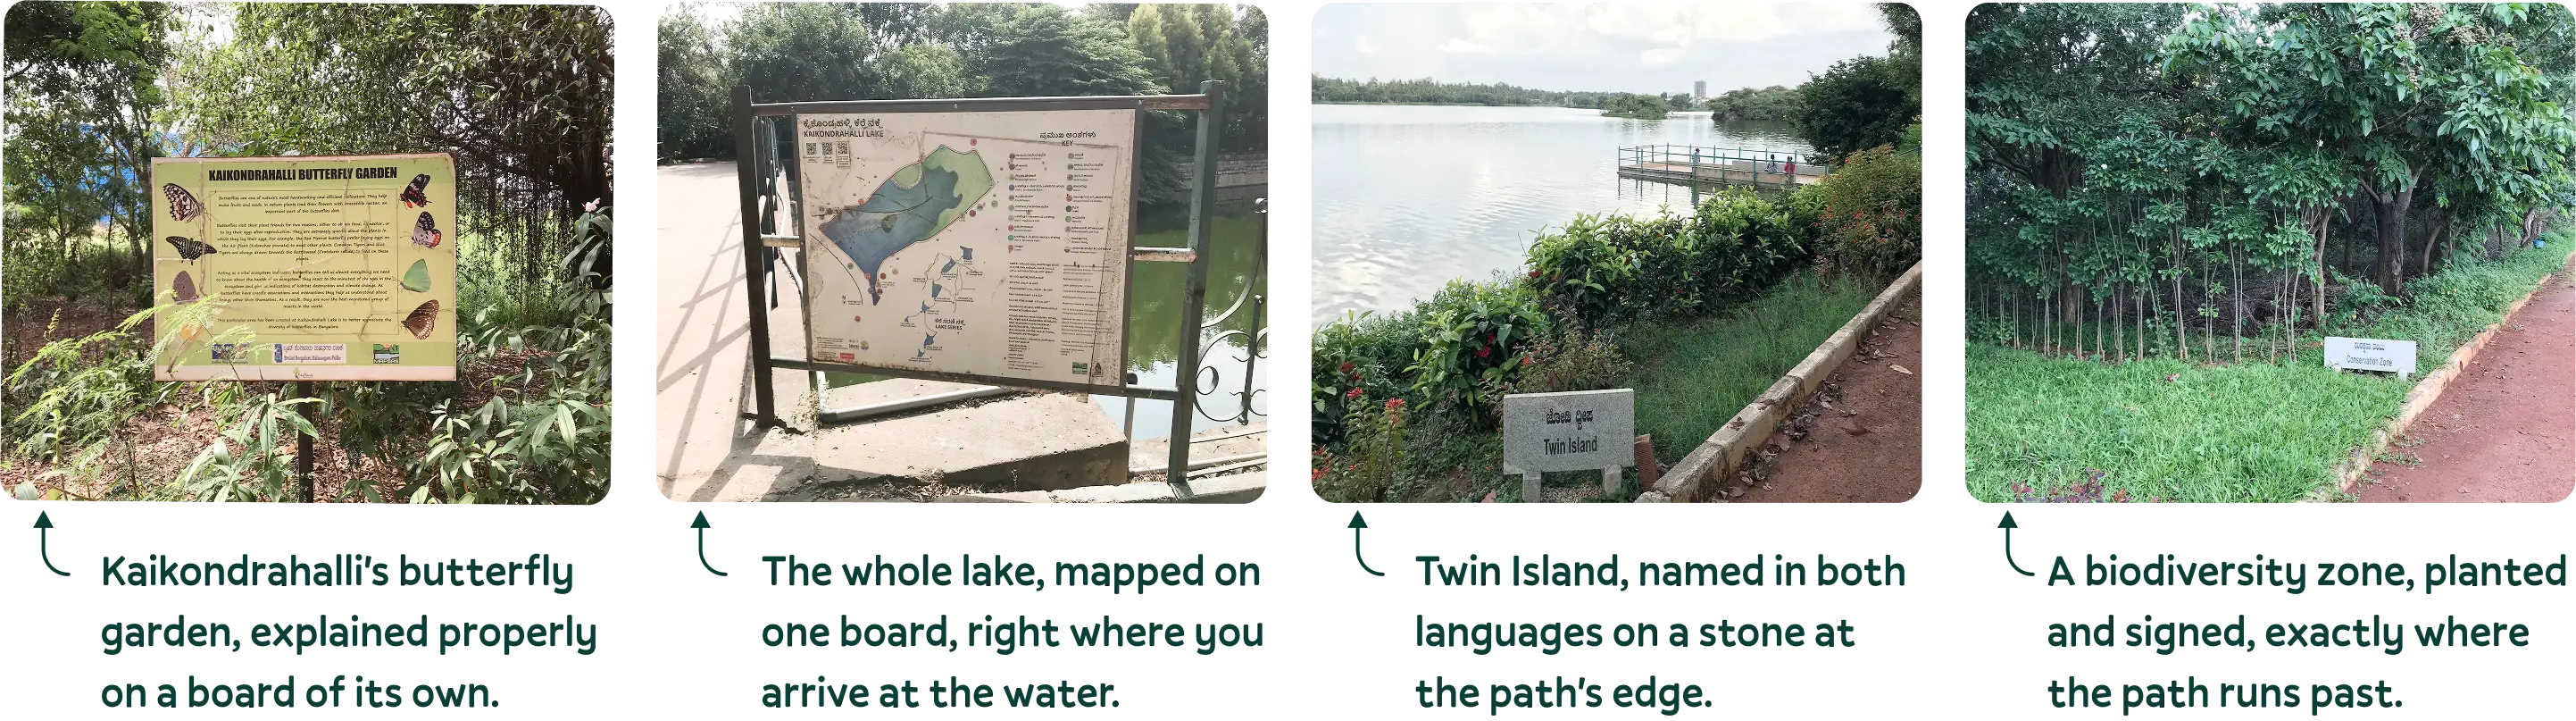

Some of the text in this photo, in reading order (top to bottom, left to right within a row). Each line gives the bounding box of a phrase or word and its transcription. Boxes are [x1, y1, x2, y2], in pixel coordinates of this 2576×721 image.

[209, 167, 397, 181] KAIKONDRAHALLI BUTTERFLY GARDEN
[2347, 354, 2393, 367] Conservation Zone
[1544, 436, 1597, 455] Twin Island
